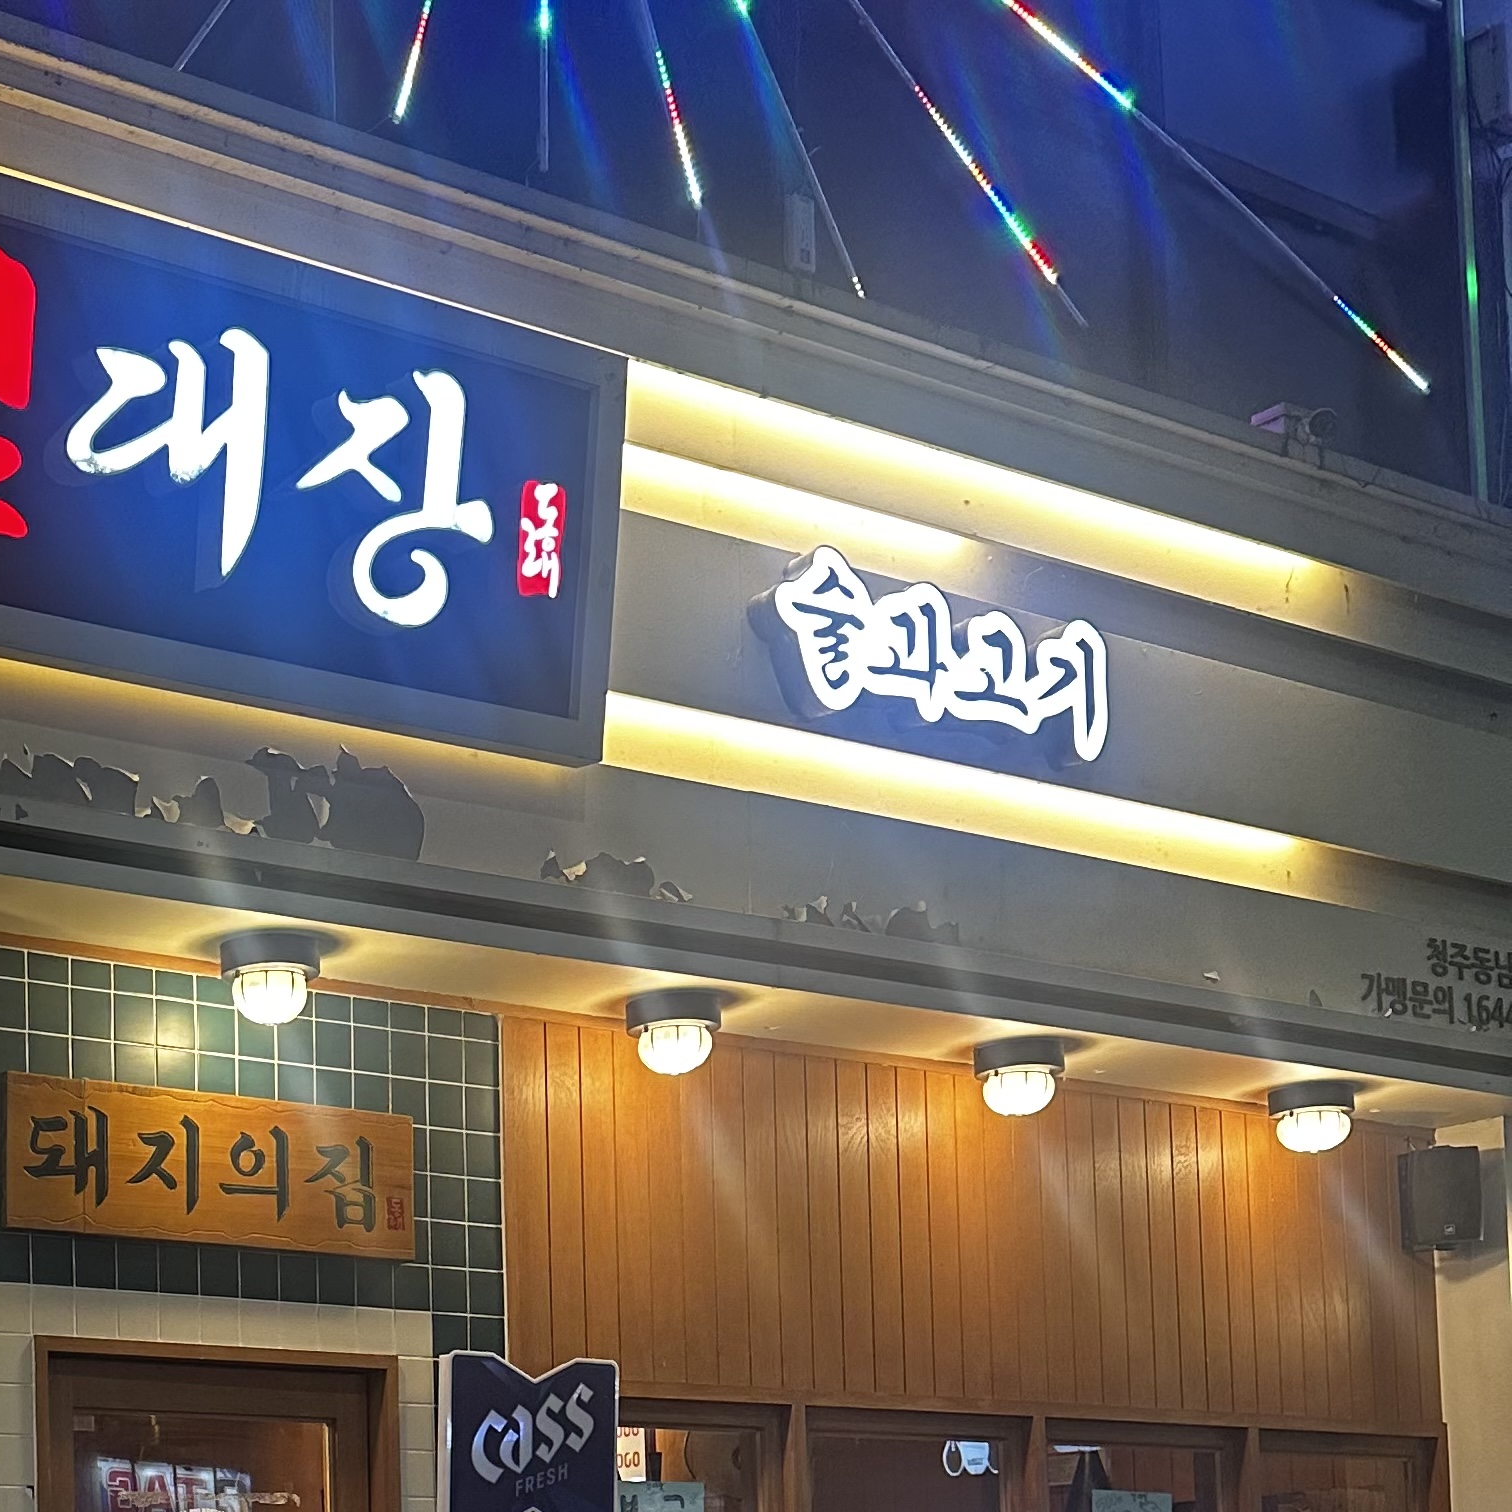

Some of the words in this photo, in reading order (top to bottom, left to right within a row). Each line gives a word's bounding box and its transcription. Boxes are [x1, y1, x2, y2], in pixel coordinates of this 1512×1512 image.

[783, 555, 1102, 754] 술과고기
[1361, 972, 1455, 1024] 가맹문의
[22, 1105, 376, 1234] 돼지의집
[514, 1463, 569, 1498] FRESH
